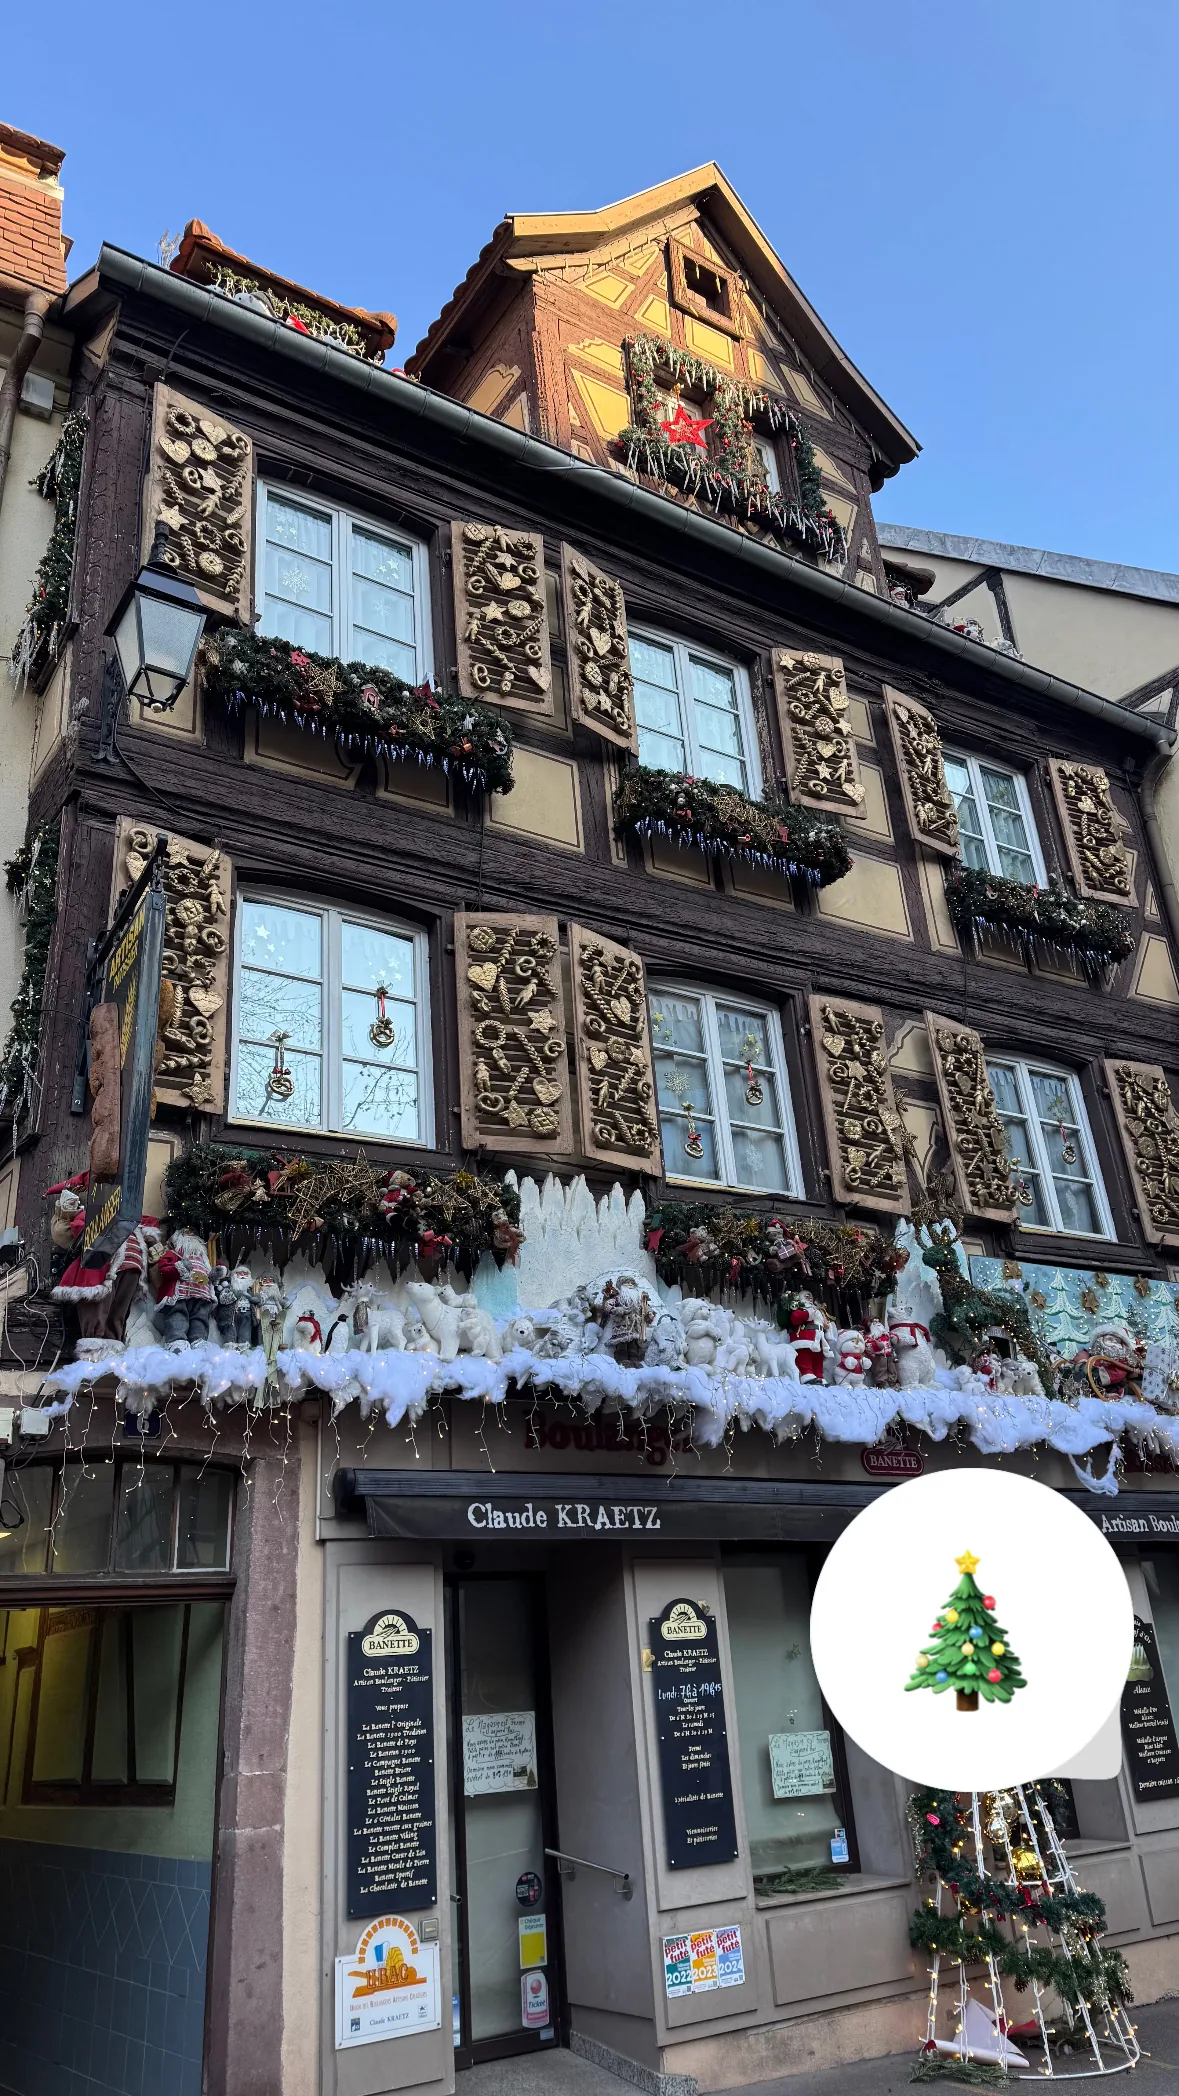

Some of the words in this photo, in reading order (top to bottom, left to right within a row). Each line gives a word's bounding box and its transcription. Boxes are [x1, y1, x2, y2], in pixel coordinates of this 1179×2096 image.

[136, 1414, 150, 1433] 6
[869, 1454, 918, 1468] BANETTE
[467, 1503, 547, 1529] Claude
[555, 1504, 661, 1530] KRAETZ
[1101, 1514, 1149, 1533] Artisan
[667, 1625, 702, 1635] BANETTE
[369, 1639, 413, 1650] BANETTE
[683, 1649, 709, 1657] KRAETZ
[363, 1667, 386, 1676] Claude
[387, 1666, 419, 1675] KRAETZ
[375, 1676, 402, 1686] Boulanger
[389, 1704, 409, 1712] propose
[396, 1718, 422, 1730] Originale
[366, 1732, 386, 1740] Banette
[402, 1728, 427, 1737] Tradition
[397, 1738, 403, 1746] de
[372, 1759, 401, 1768] Campagne
[379, 1776, 395, 1787] Seigle
[387, 1784, 403, 1796] Seigle
[404, 1782, 420, 1793] Royal
[391, 1794, 398, 1803] de
[398, 1793, 419, 1802] Colmar
[379, 1812, 401, 1823] Céréales
[402, 1812, 422, 1820] Banette
[363, 1827, 383, 1835] Banette
[413, 1820, 432, 1831] graines
[379, 1834, 399, 1842] Banette
[400, 1831, 418, 1841] Viking
[376, 1842, 399, 1853] Complet
[400, 1841, 420, 1849] Banette
[370, 1855, 390, 1863] Banette
[408, 1849, 415, 1857] de
[367, 1865, 387, 1873] Banette
[388, 1860, 405, 1870] Meule
[406, 1859, 412, 1867] de
[396, 1869, 414, 1881] Sportif
[401, 1880, 407, 1888] de
[408, 1879, 428, 1887] Banette
[524, 1923, 545, 1931] Déjeuner
[690, 1934, 713, 1953] petit
[716, 1930, 738, 1948] petit
[664, 1939, 688, 1958] petit
[696, 1944, 715, 1959] futé
[721, 1939, 740, 1954] futé
[670, 1949, 689, 1963] futé
[692, 1965, 718, 1979] 2023
[719, 1960, 743, 1974] 2024
[366, 1963, 409, 1989] UBAC
[667, 1970, 692, 1985] 2022
[369, 2018, 386, 2026] Claude
[387, 2013, 410, 2022] KRAETZ
